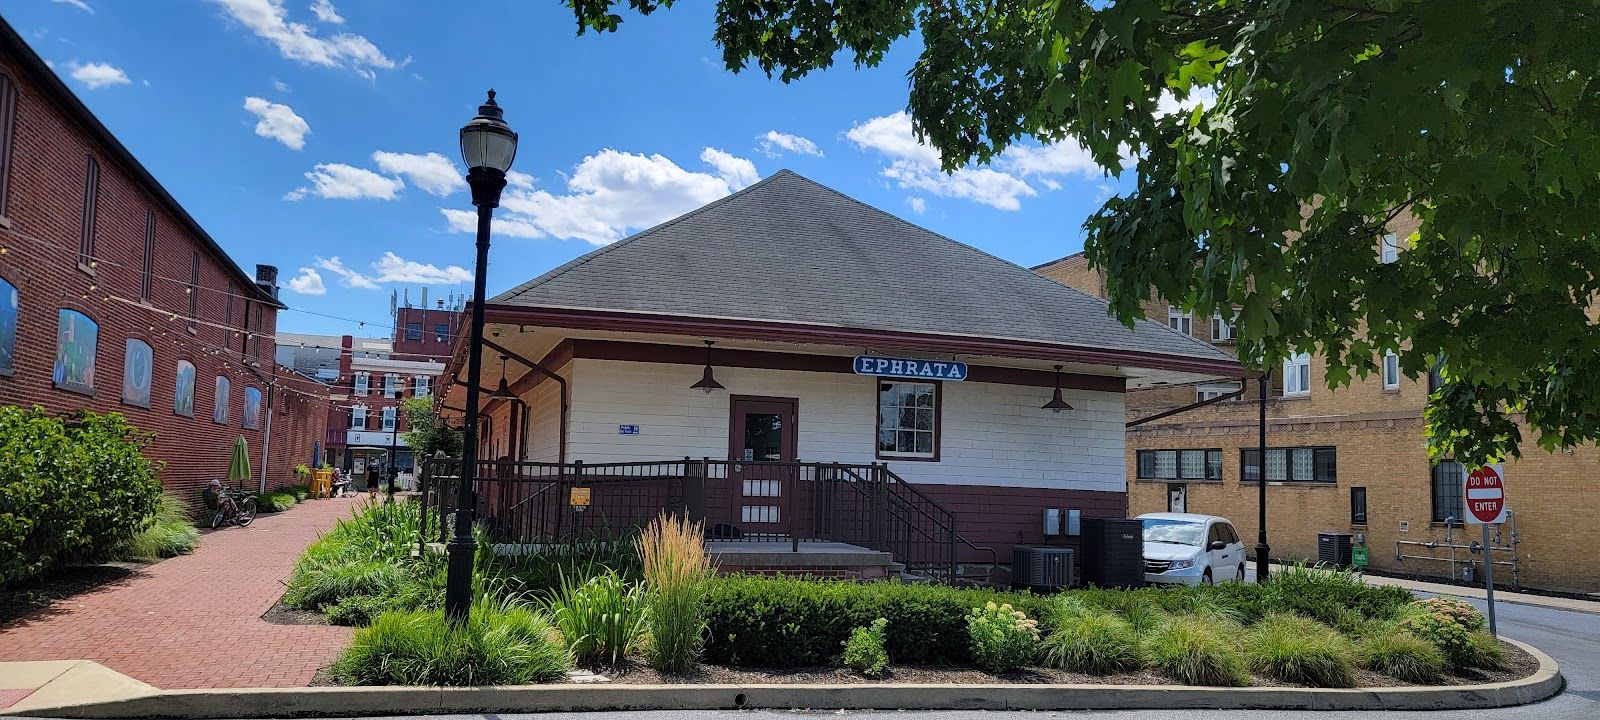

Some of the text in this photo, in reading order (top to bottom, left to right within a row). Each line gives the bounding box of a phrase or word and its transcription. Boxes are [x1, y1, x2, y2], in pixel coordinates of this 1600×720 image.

[861, 358, 962, 378] EPHRATA
[1470, 477, 1497, 486] DO NOT
[1475, 502, 1497, 511] ENTER
